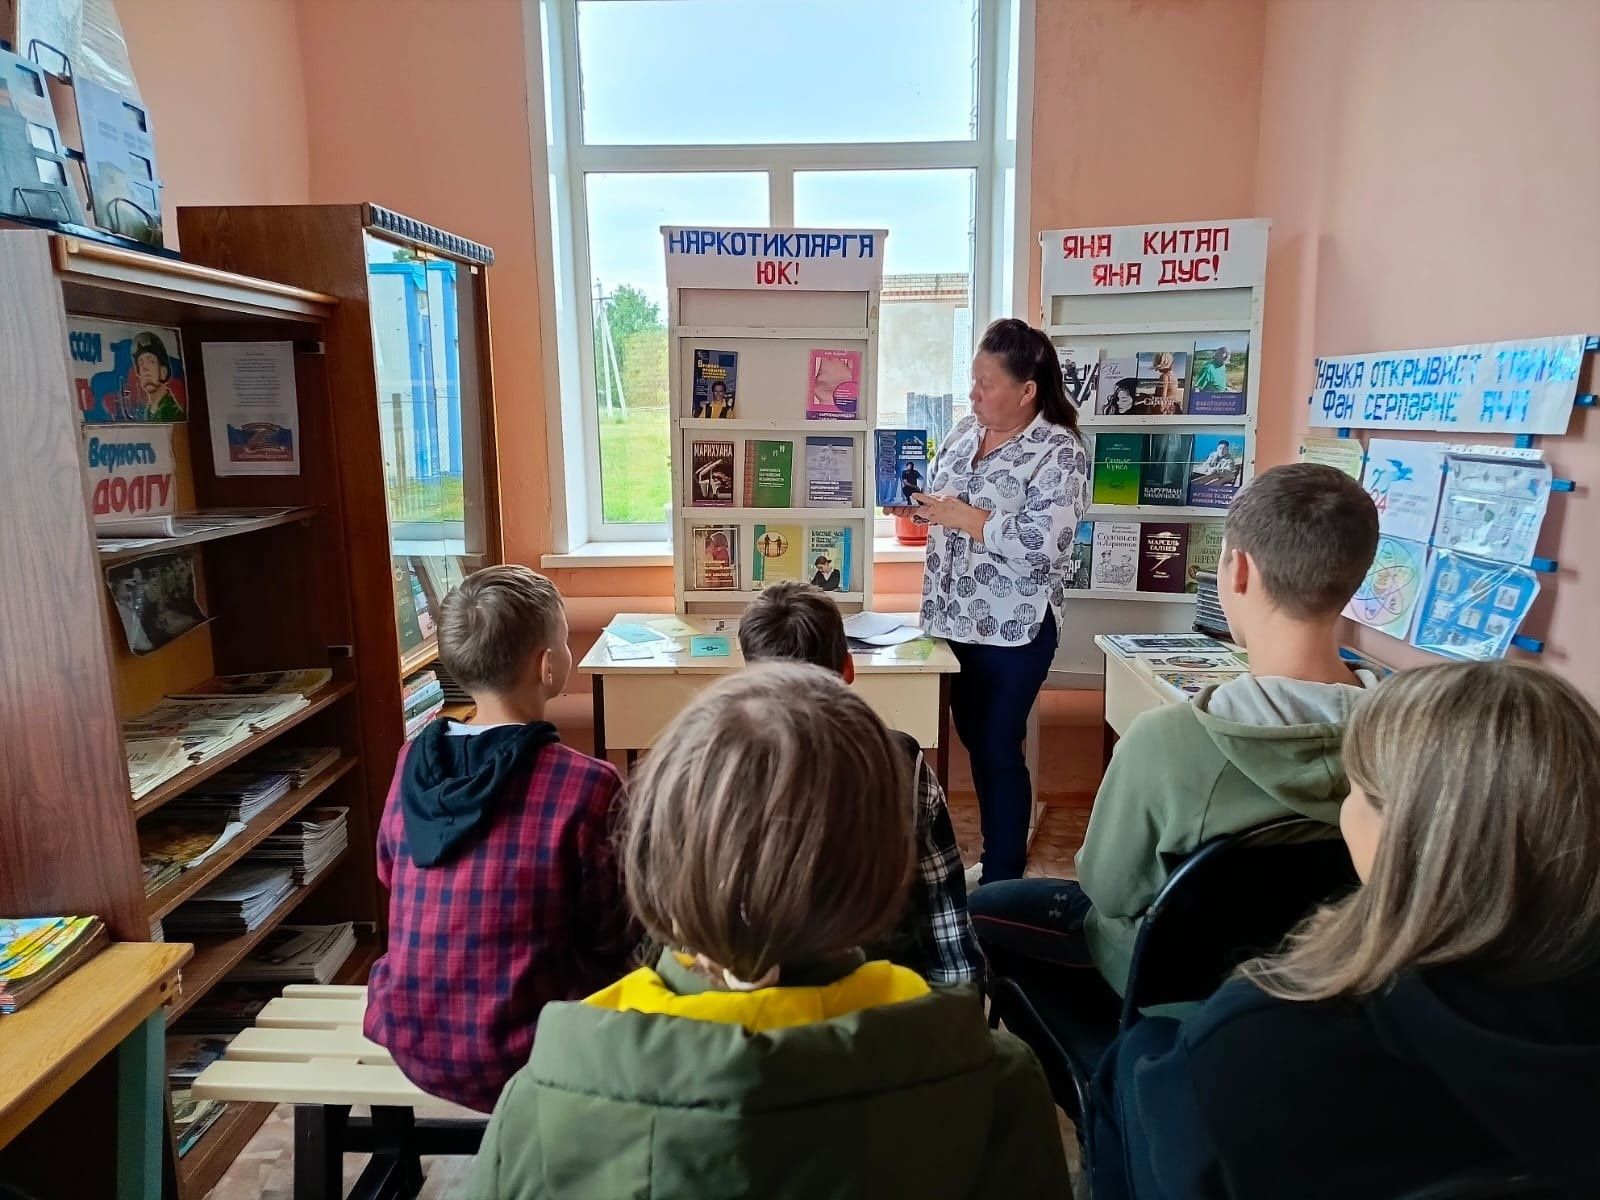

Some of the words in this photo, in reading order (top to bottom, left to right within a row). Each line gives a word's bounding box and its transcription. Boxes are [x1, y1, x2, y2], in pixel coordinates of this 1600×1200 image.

[669, 230, 874, 258] НАРКОТИКЛАРГА
[1143, 228, 1229, 255] КИТАП
[756, 260, 800, 285] ЮК!
[1158, 254, 1220, 286] ДУС!
[1316, 359, 1365, 389] НАУКА
[1370, 352, 1483, 389] ОТКРЫВАЕТ
[88, 437, 155, 473] Верность
[693, 443, 733, 457] МАРИХУАНА
[92, 474, 172, 514] ДОЛГУ
[1147, 539, 1180, 548] МАРСЕЛЬ
